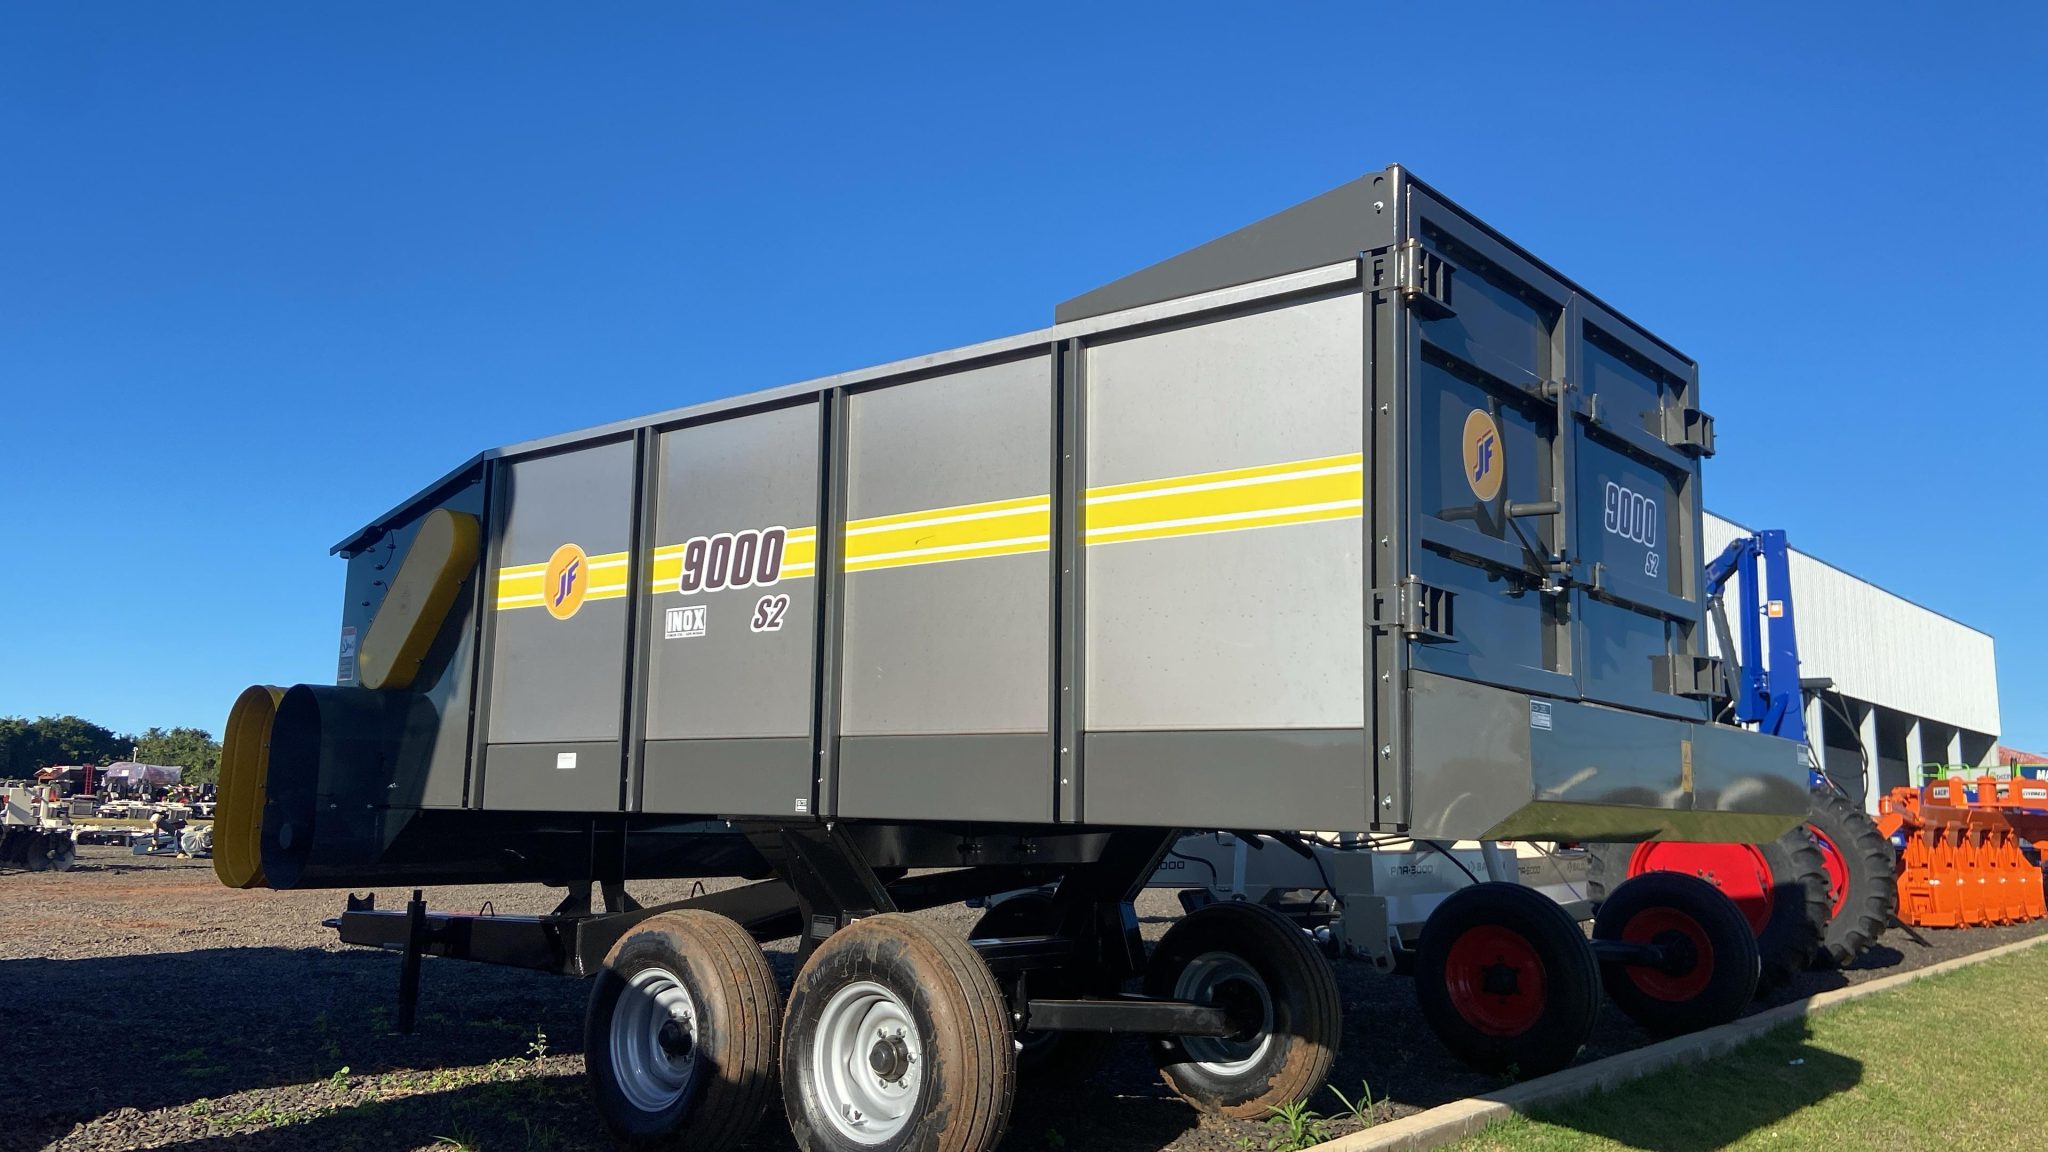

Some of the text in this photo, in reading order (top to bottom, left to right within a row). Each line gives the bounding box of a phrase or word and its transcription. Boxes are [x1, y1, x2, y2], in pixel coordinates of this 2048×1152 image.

[1473, 429, 1494, 484] JF
[1605, 481, 1656, 548] 9000
[553, 556, 580, 608] JF
[680, 528, 786, 593] 9000
[1645, 551, 1659, 577] S2
[667, 608, 705, 633] INOX
[752, 595, 789, 631] S2
